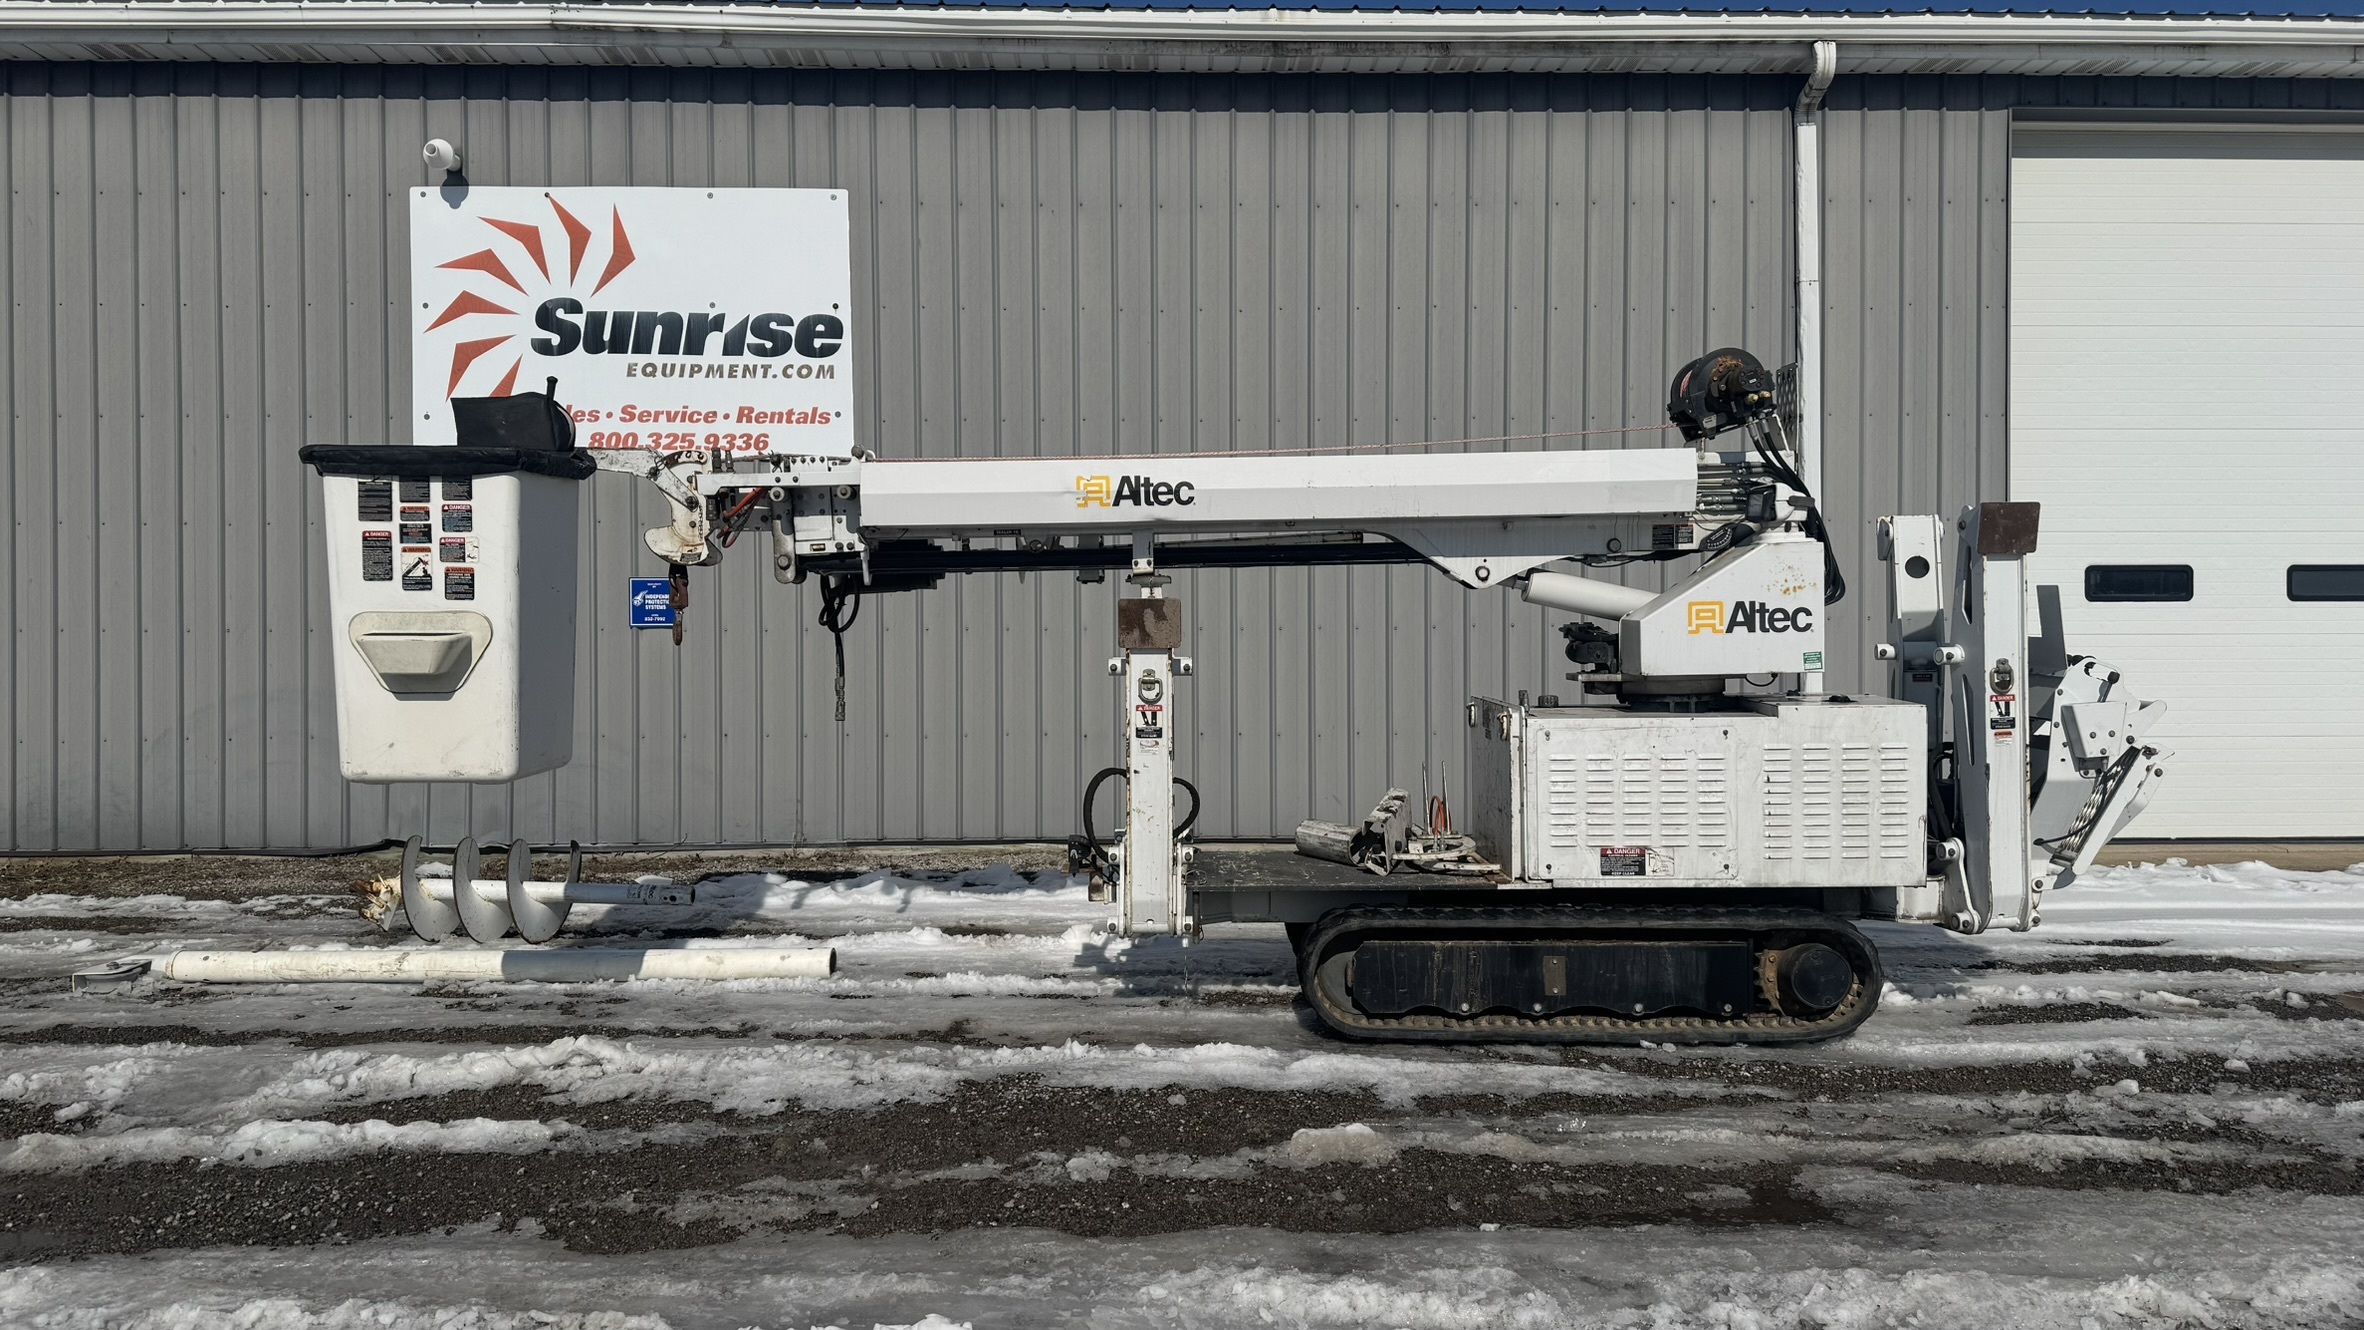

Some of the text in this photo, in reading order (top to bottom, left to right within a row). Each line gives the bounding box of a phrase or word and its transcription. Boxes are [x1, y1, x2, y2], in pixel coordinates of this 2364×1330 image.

[530, 297, 844, 358] Sunrise
[626, 362, 836, 379] EQUIPMENT.COM
[566, 404, 832, 425] les Service Rentals
[588, 431, 770, 452] 800.325.9336
[1112, 475, 1195, 506] Altec
[1725, 600, 1813, 634] Altec
